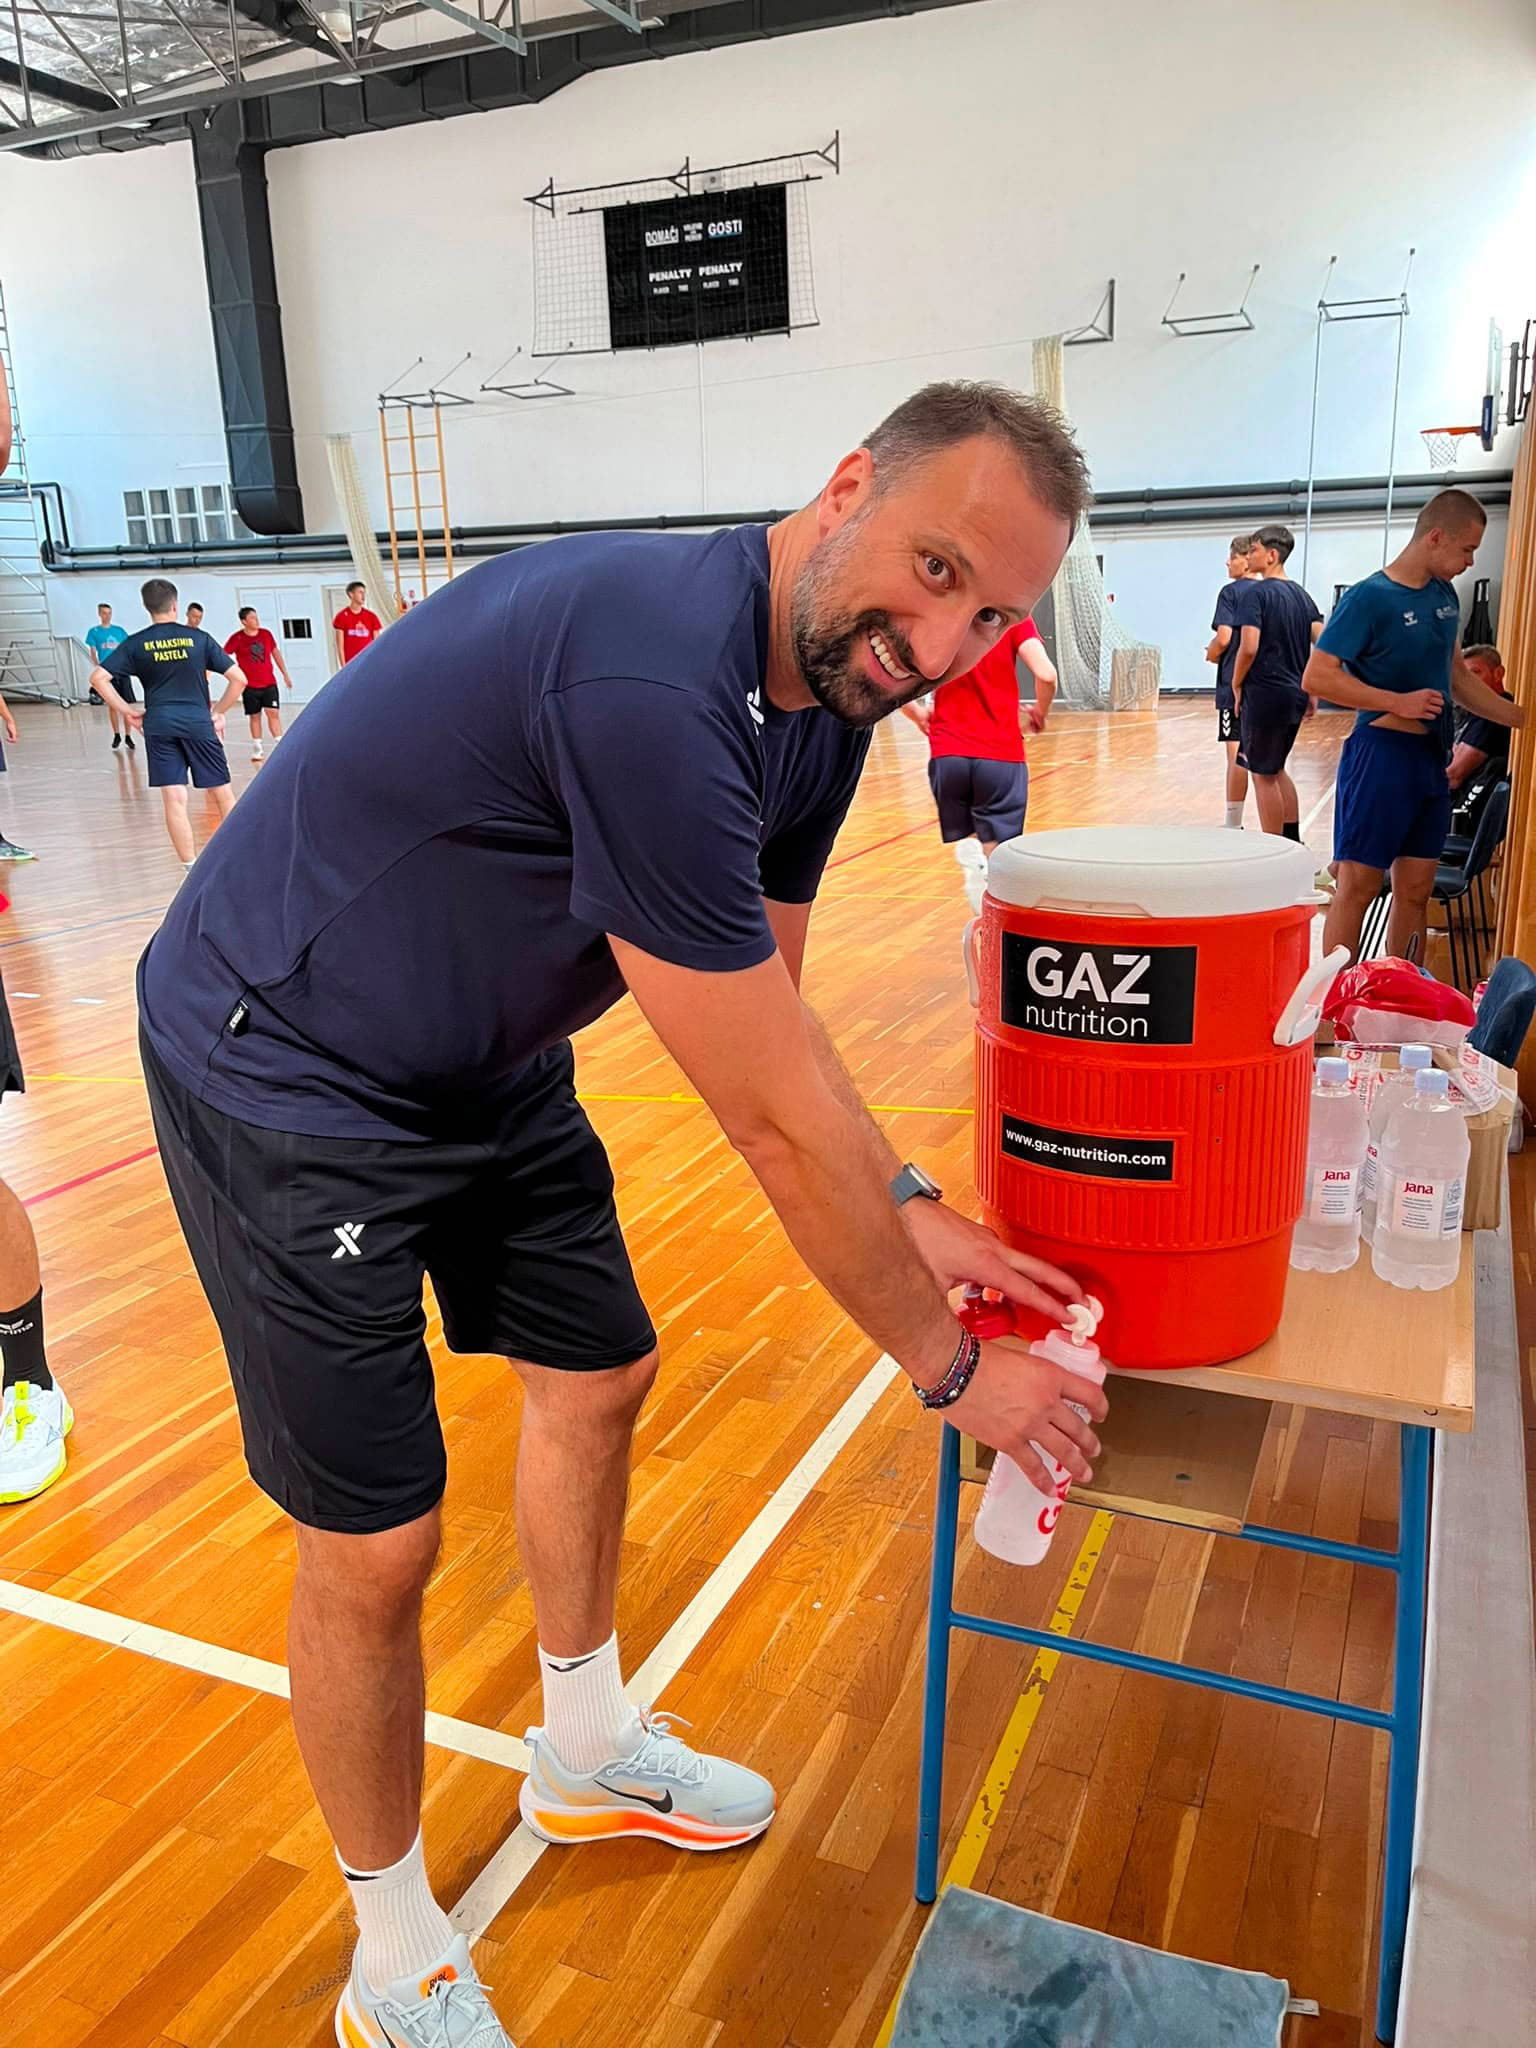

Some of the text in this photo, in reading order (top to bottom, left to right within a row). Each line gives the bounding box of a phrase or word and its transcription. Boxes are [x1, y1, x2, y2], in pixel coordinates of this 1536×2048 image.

[707, 219, 743, 237] GOSTI
[649, 262, 743, 282] PENALTY PENALTY
[155, 637, 194, 650] MAKSIMIR
[154, 649, 188, 661] PASTELA
[1026, 946, 1151, 1005] GAZ
[1025, 1004, 1149, 1038] nutrition
[1005, 1128, 1167, 1166] www.gaz-nutrition.com
[1323, 1170, 1351, 1182] Jana
[1403, 1182, 1433, 1195] Jana
